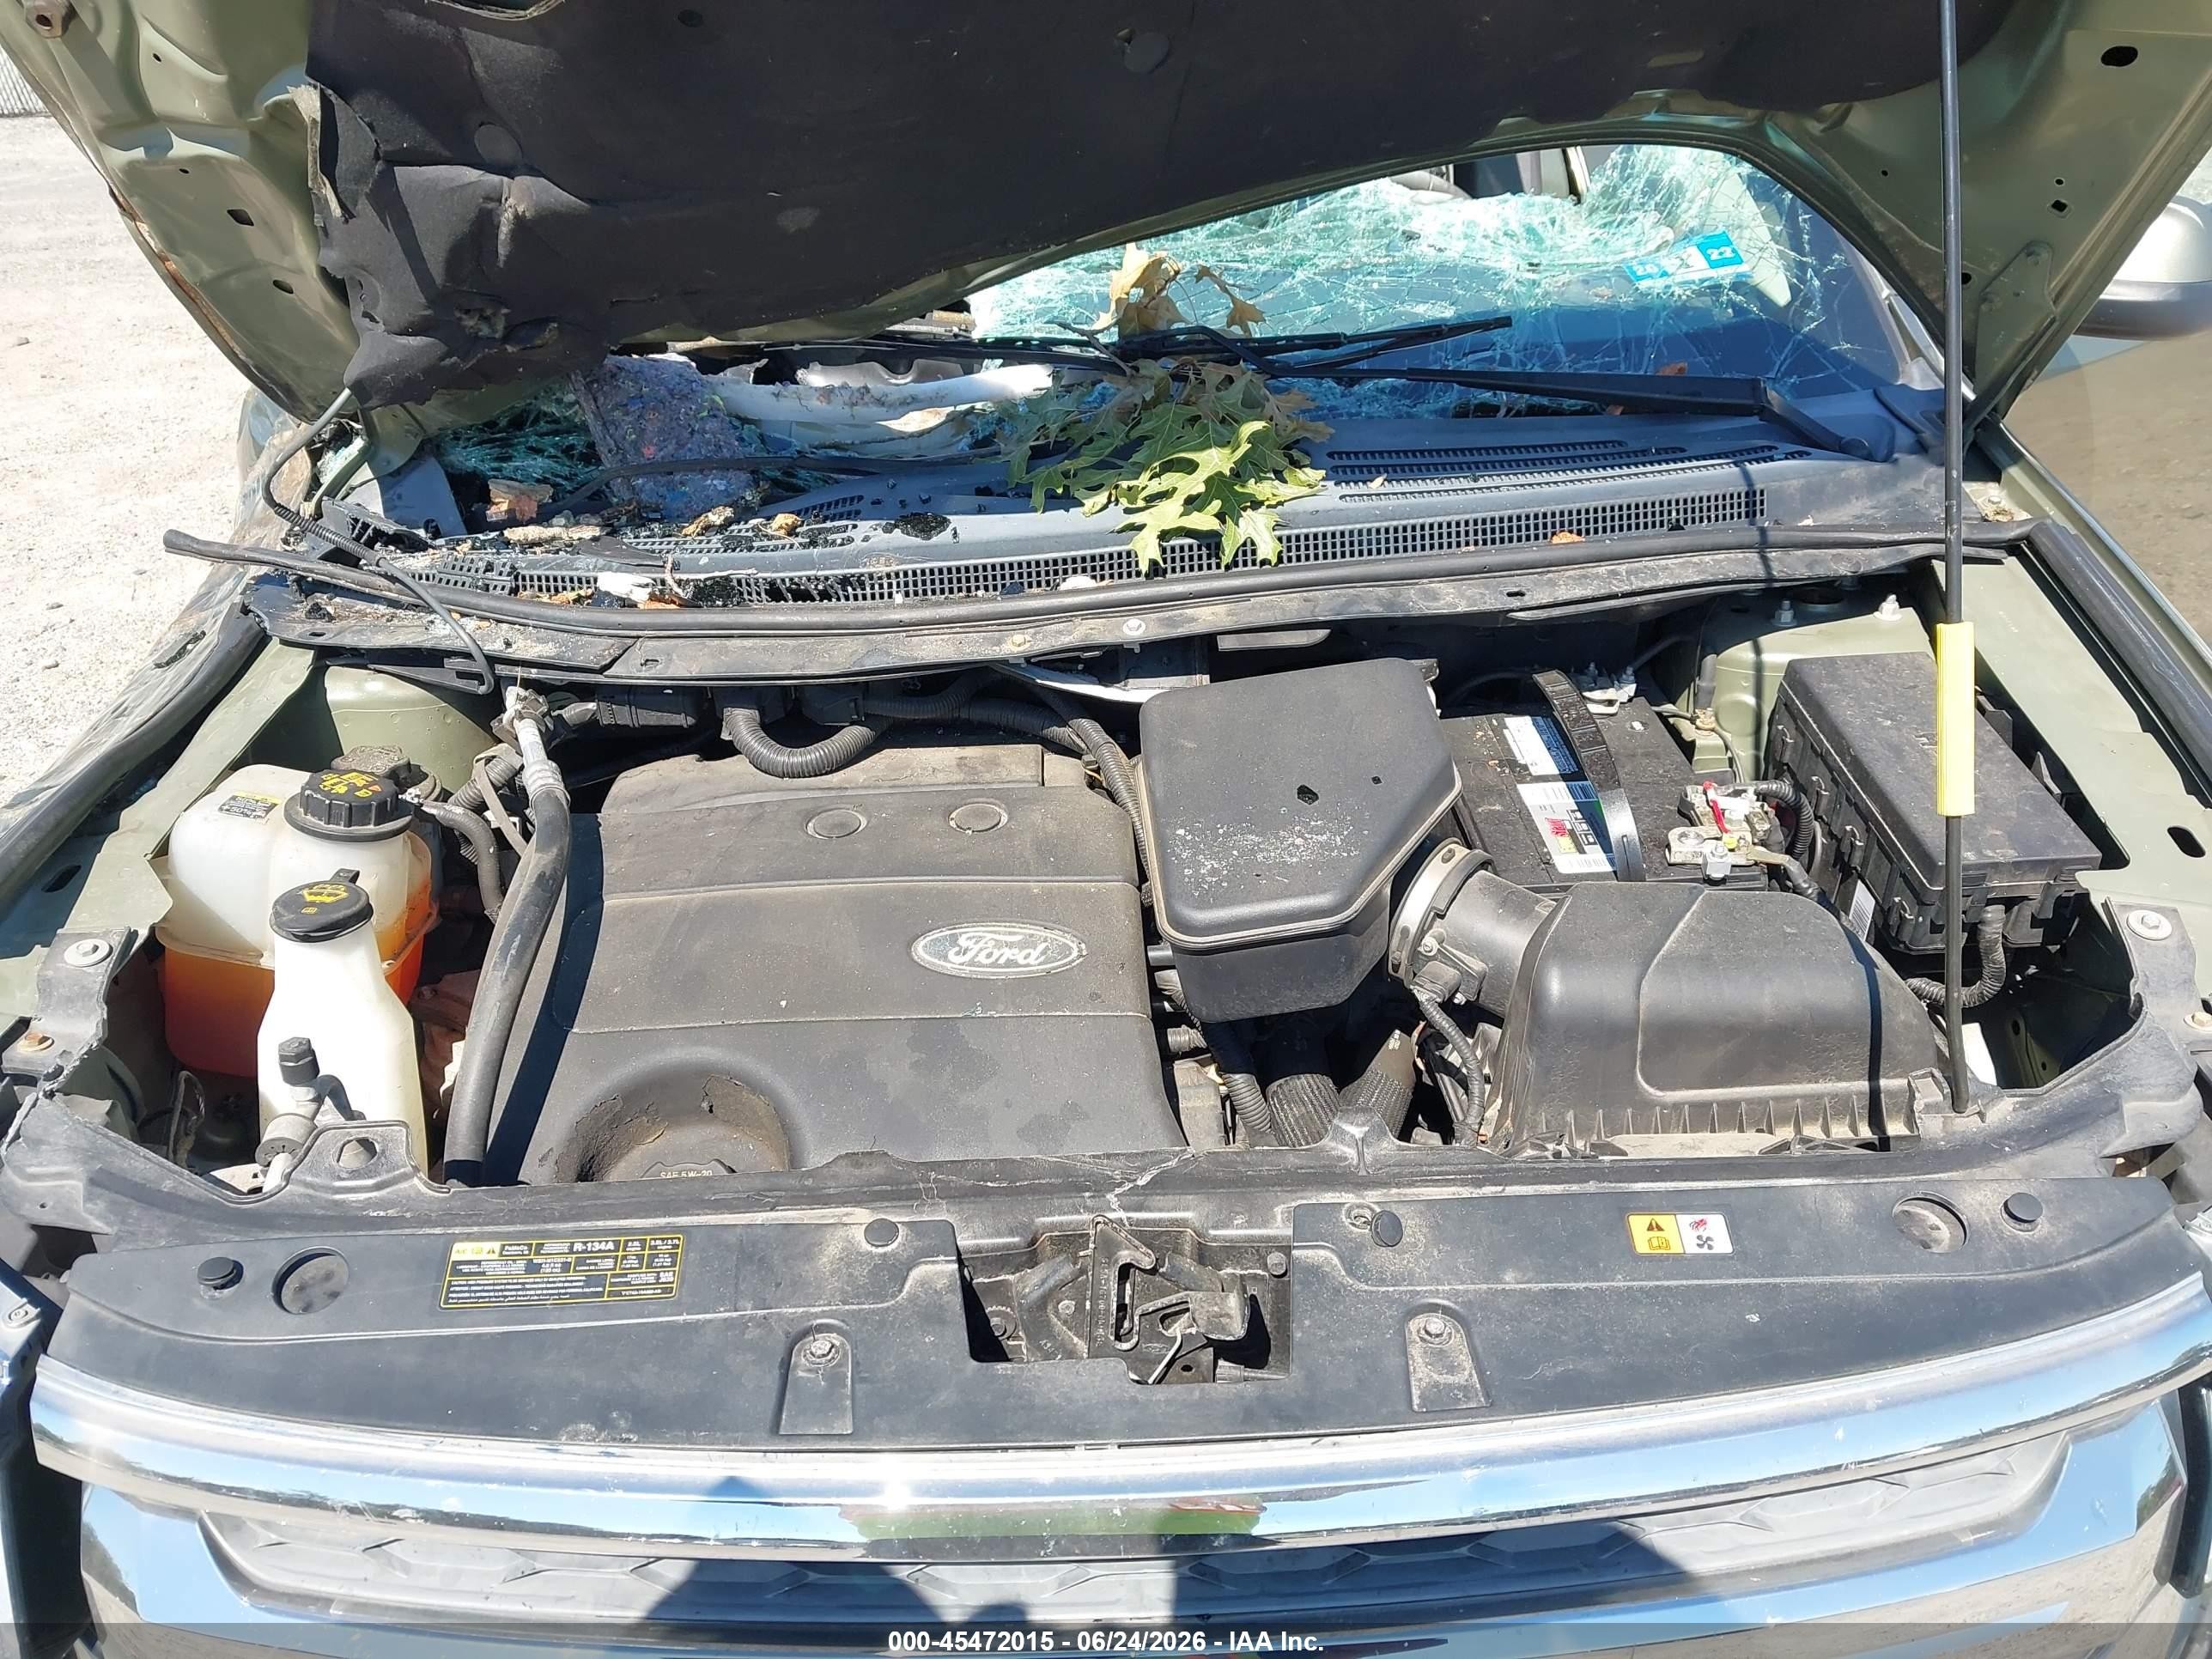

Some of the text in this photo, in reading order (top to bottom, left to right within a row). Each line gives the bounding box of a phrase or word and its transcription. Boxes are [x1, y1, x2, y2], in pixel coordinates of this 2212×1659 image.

[1706, 246, 1735, 261] 22
[948, 931, 1049, 965] Ford
[573, 1241, 615, 1252] R-134A
